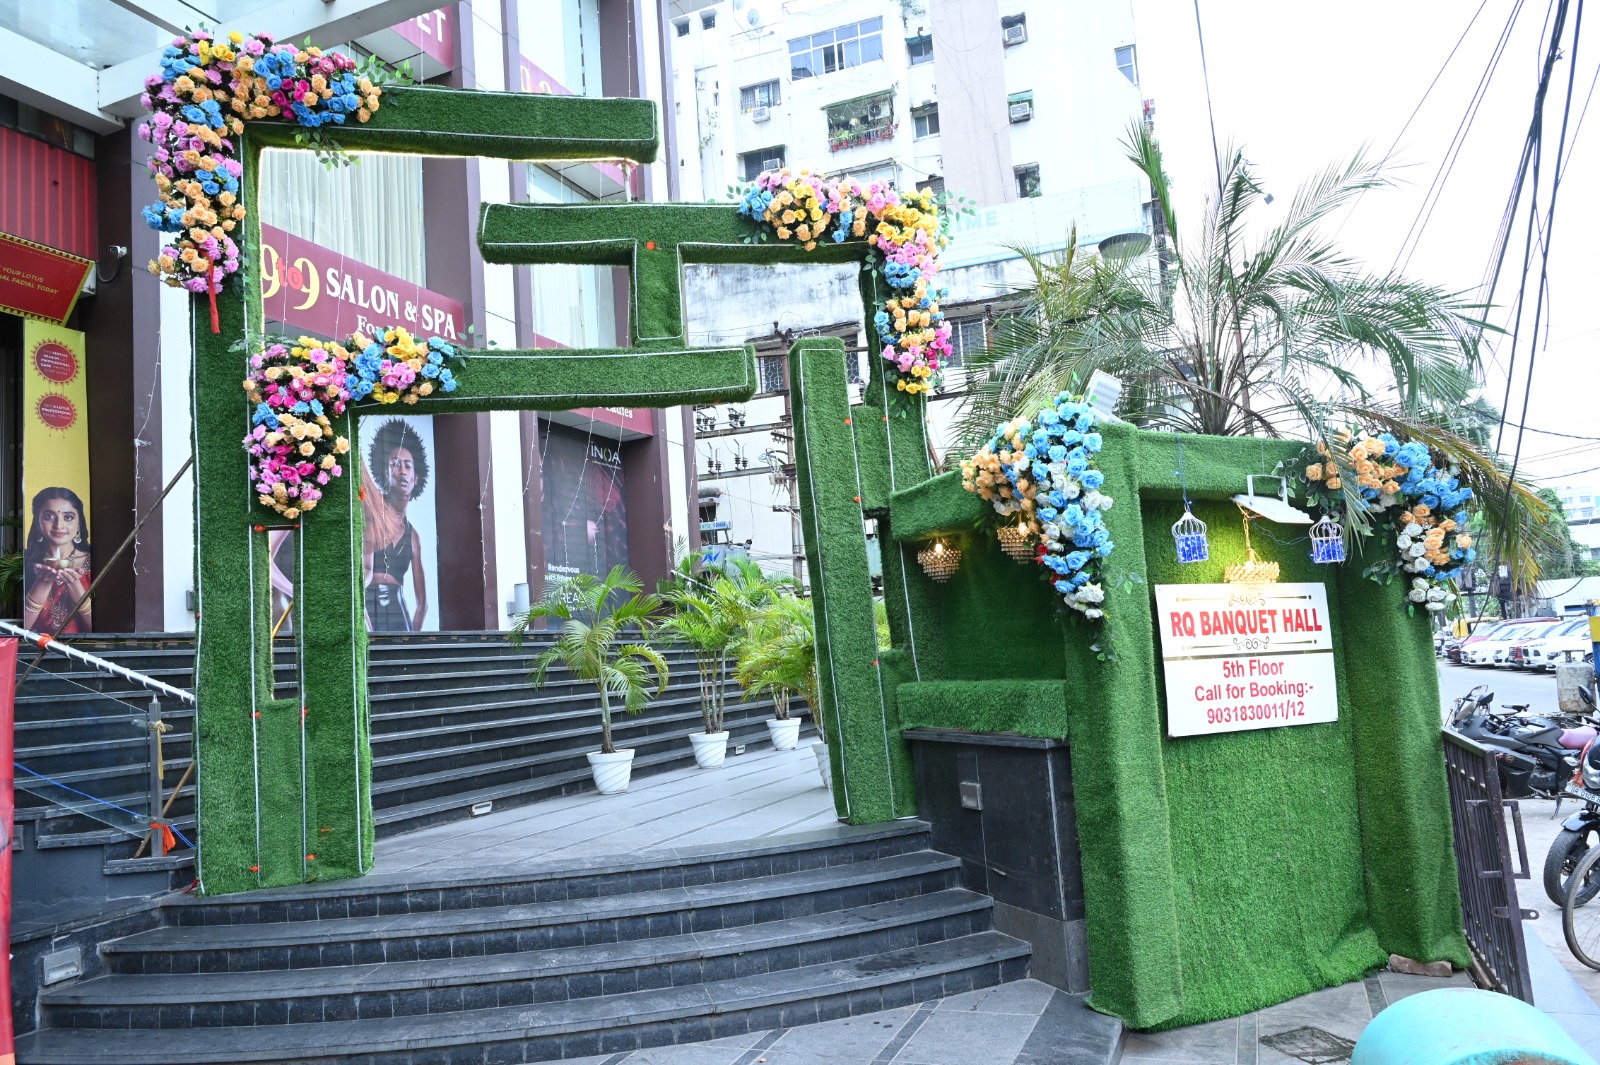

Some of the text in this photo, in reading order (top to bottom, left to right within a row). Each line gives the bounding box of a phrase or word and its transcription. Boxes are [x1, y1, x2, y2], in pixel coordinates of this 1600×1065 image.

[409, 9, 446, 43] ET
[2, 266, 44, 283] YOUR LOTUS
[11, 277, 36, 288] FACIAL
[37, 284, 59, 295] TODAY
[326, 267, 400, 320] SALON
[404, 301, 418, 323] &
[421, 304, 456, 341] SPA
[1170, 608, 1322, 638] RQ BANQUET HALL
[1223, 659, 1284, 678] 5th Floor
[1195, 680, 1314, 702] Call for Booking:-
[1206, 700, 1305, 724] 9031830011/12
